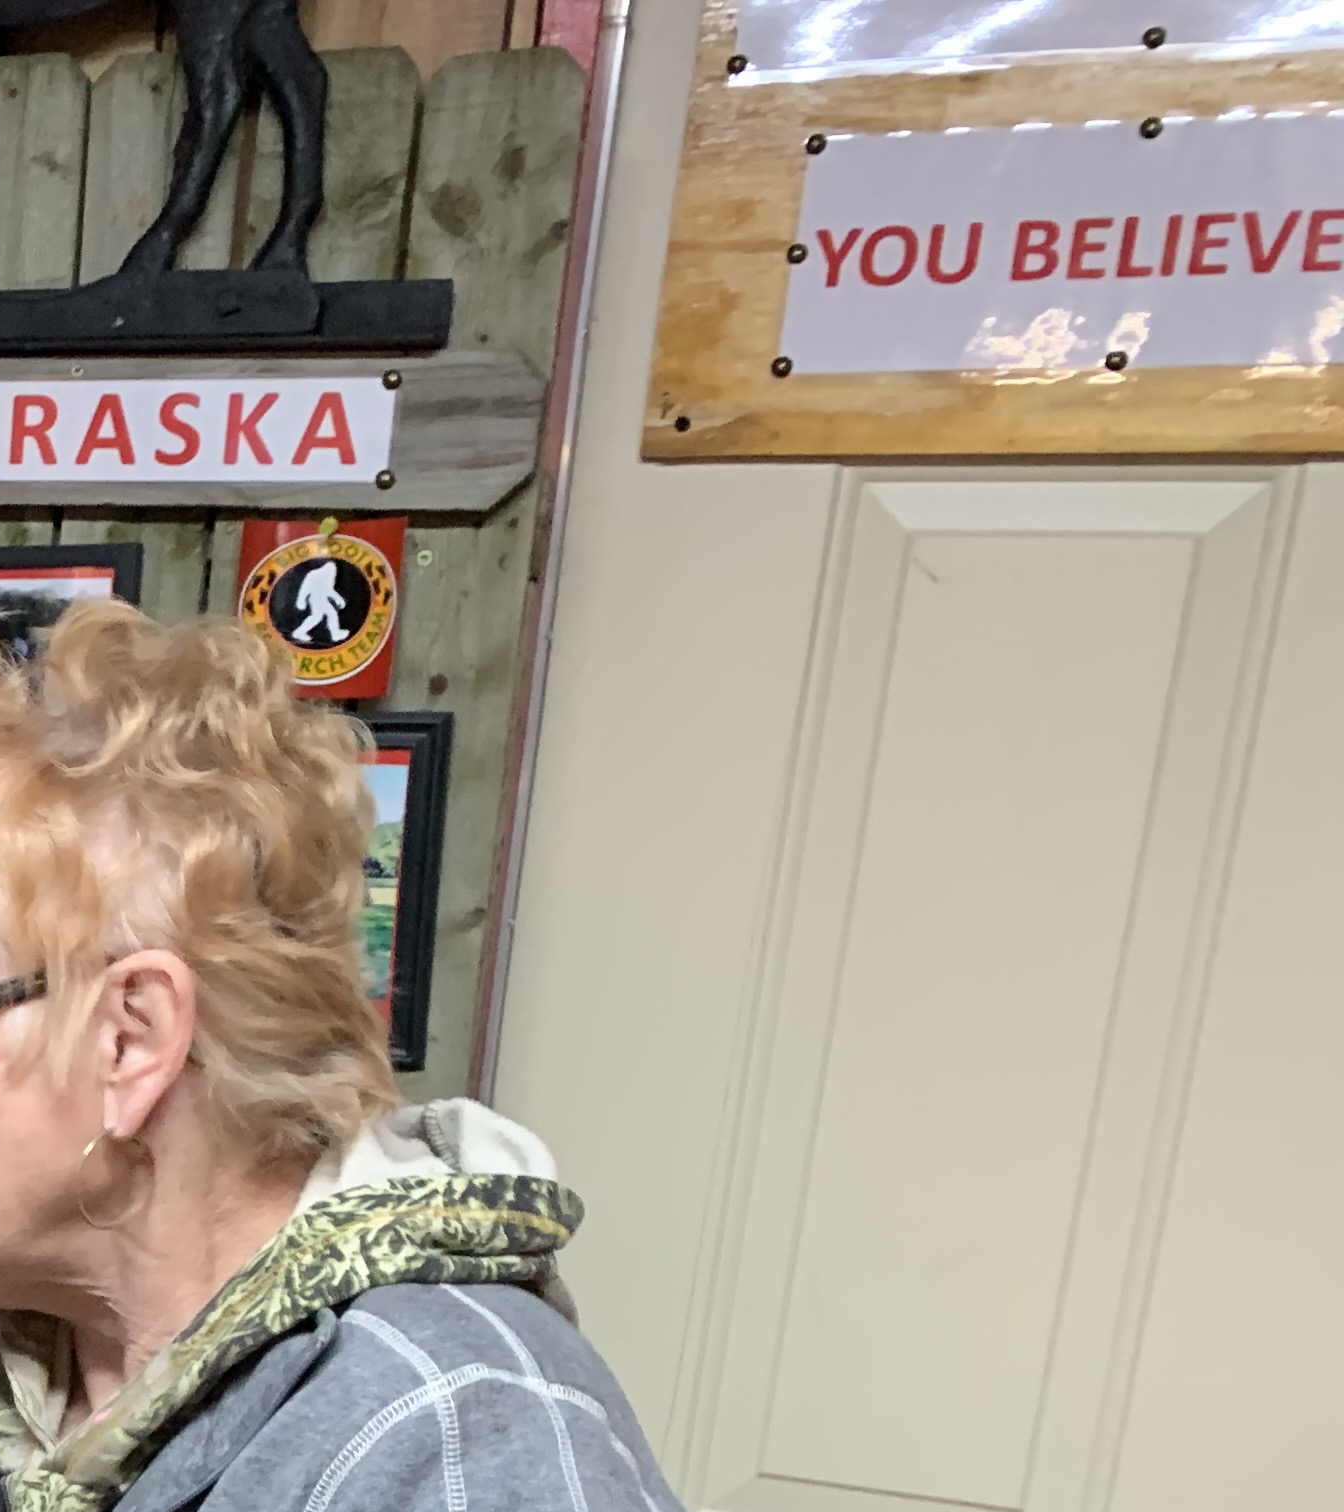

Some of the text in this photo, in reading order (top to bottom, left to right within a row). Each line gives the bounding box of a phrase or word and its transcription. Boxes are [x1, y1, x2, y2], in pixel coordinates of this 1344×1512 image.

[816, 209, 1344, 288] YOU BELIEVE
[348, 612, 385, 657] TEAM
